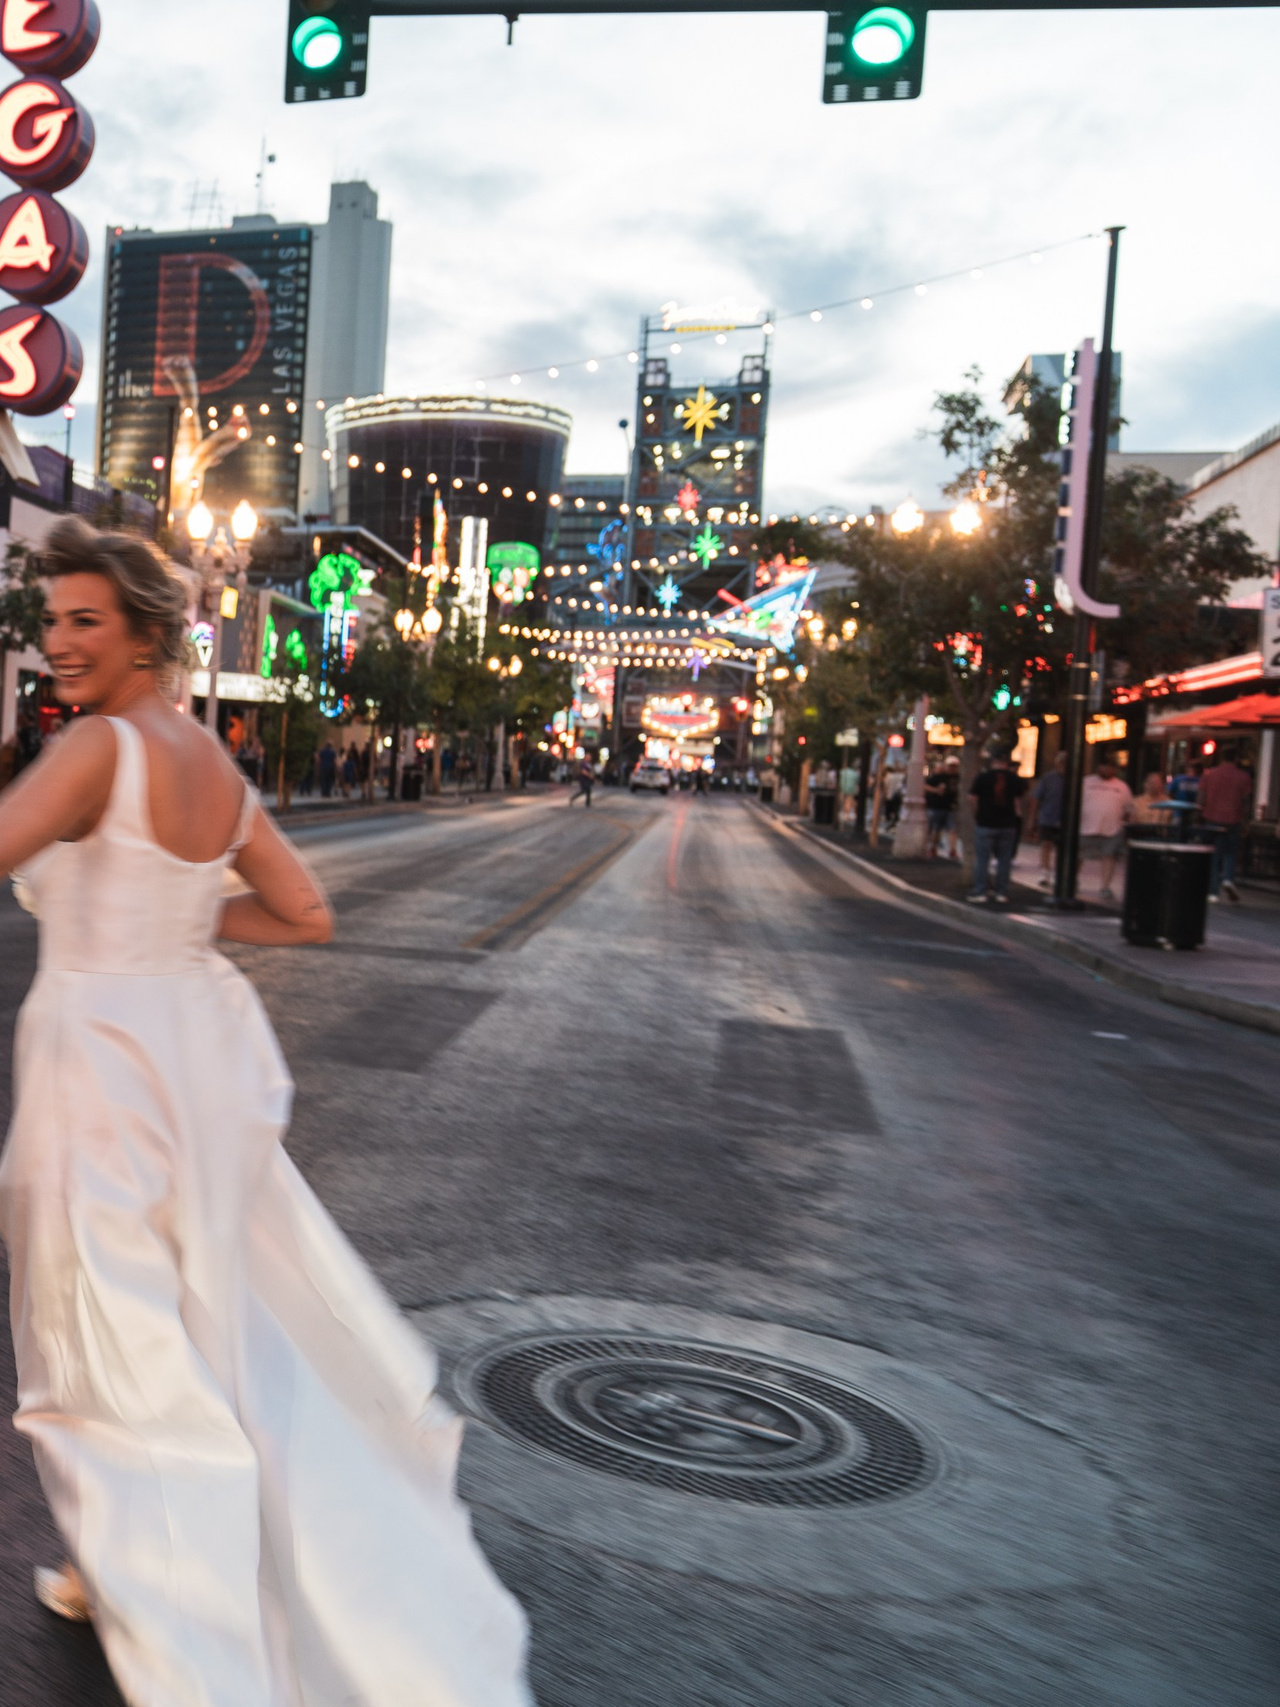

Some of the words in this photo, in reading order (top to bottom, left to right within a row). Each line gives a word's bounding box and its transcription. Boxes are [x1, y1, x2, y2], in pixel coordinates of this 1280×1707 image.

[153, 254, 270, 397] D
[274, 246, 298, 332] VEGAS
[271, 346, 293, 394] LAS
